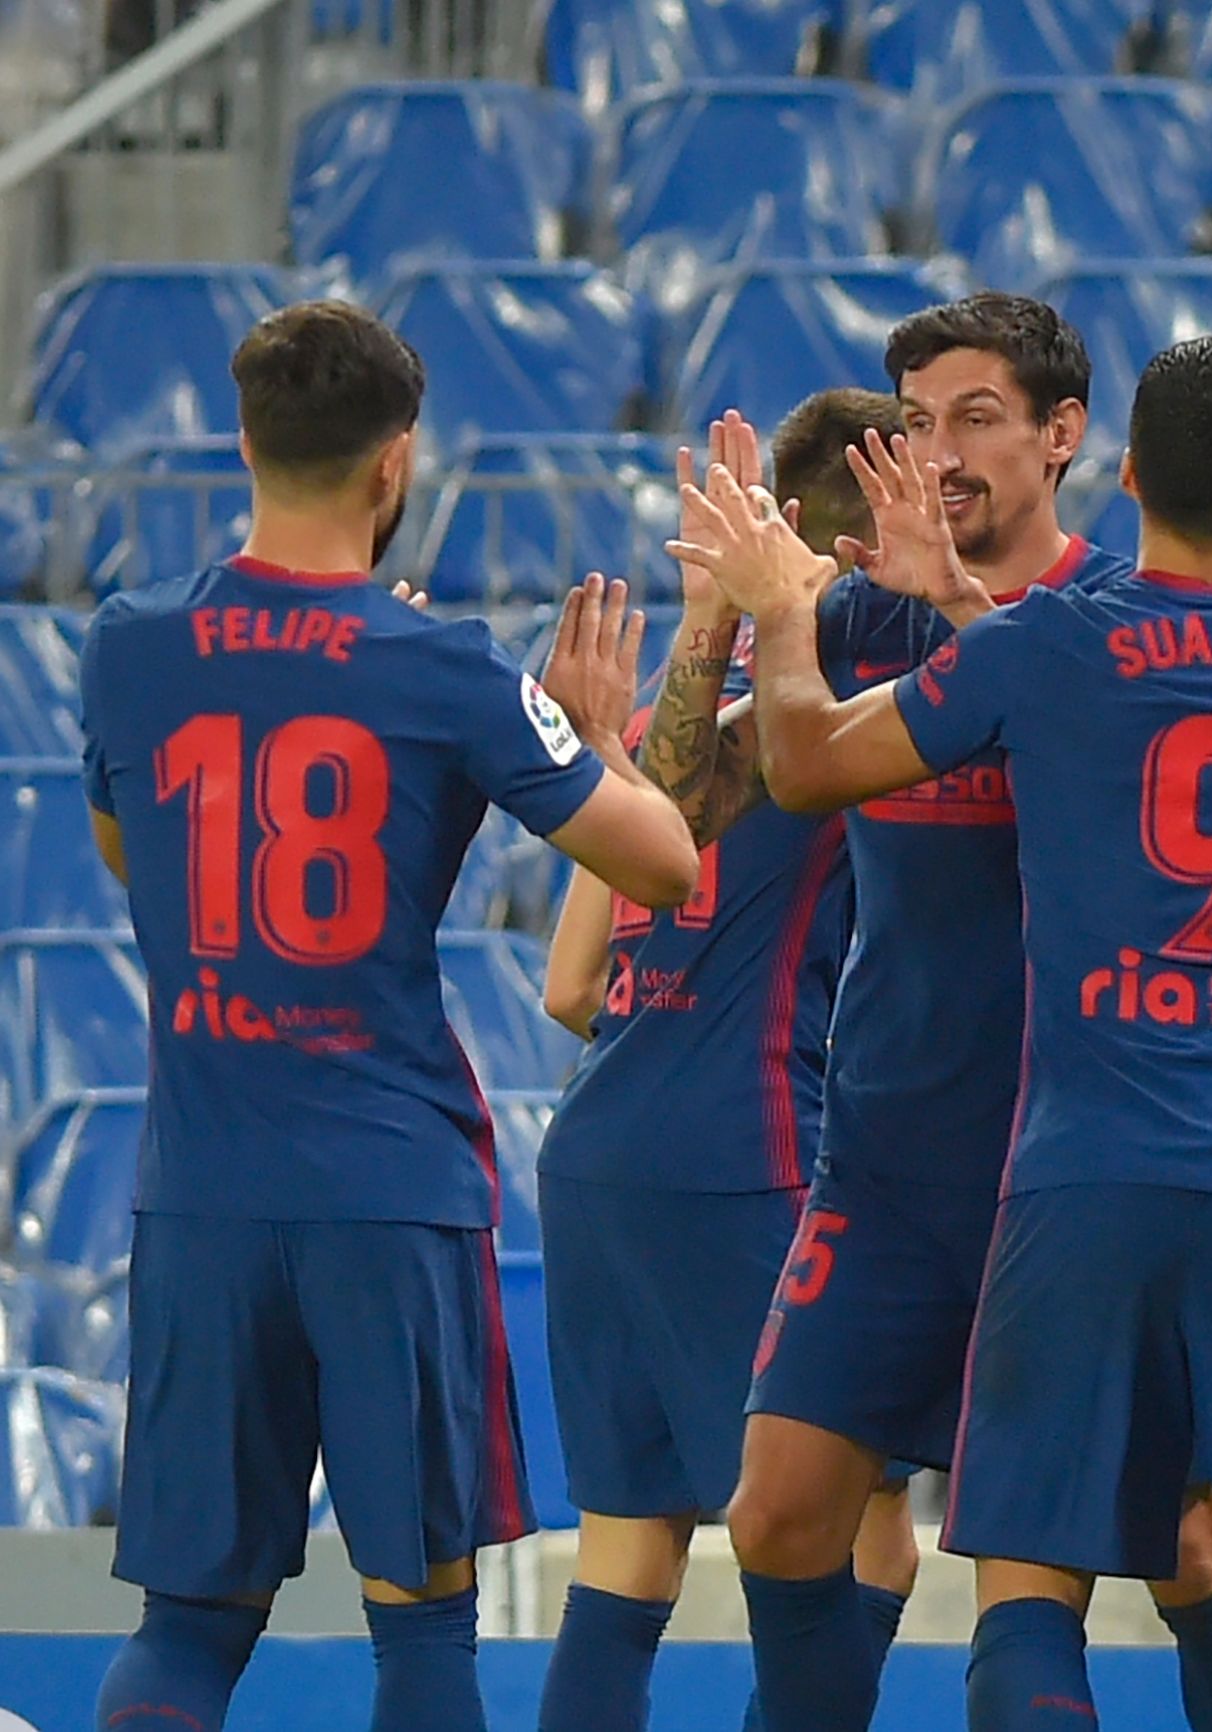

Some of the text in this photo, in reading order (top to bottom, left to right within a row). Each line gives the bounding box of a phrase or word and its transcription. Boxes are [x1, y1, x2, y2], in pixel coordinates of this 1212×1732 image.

[190, 605, 365, 663] FELIPE
[153, 712, 390, 965] 18
[174, 965, 276, 1042] ria
[1080, 947, 1197, 1026] ria
